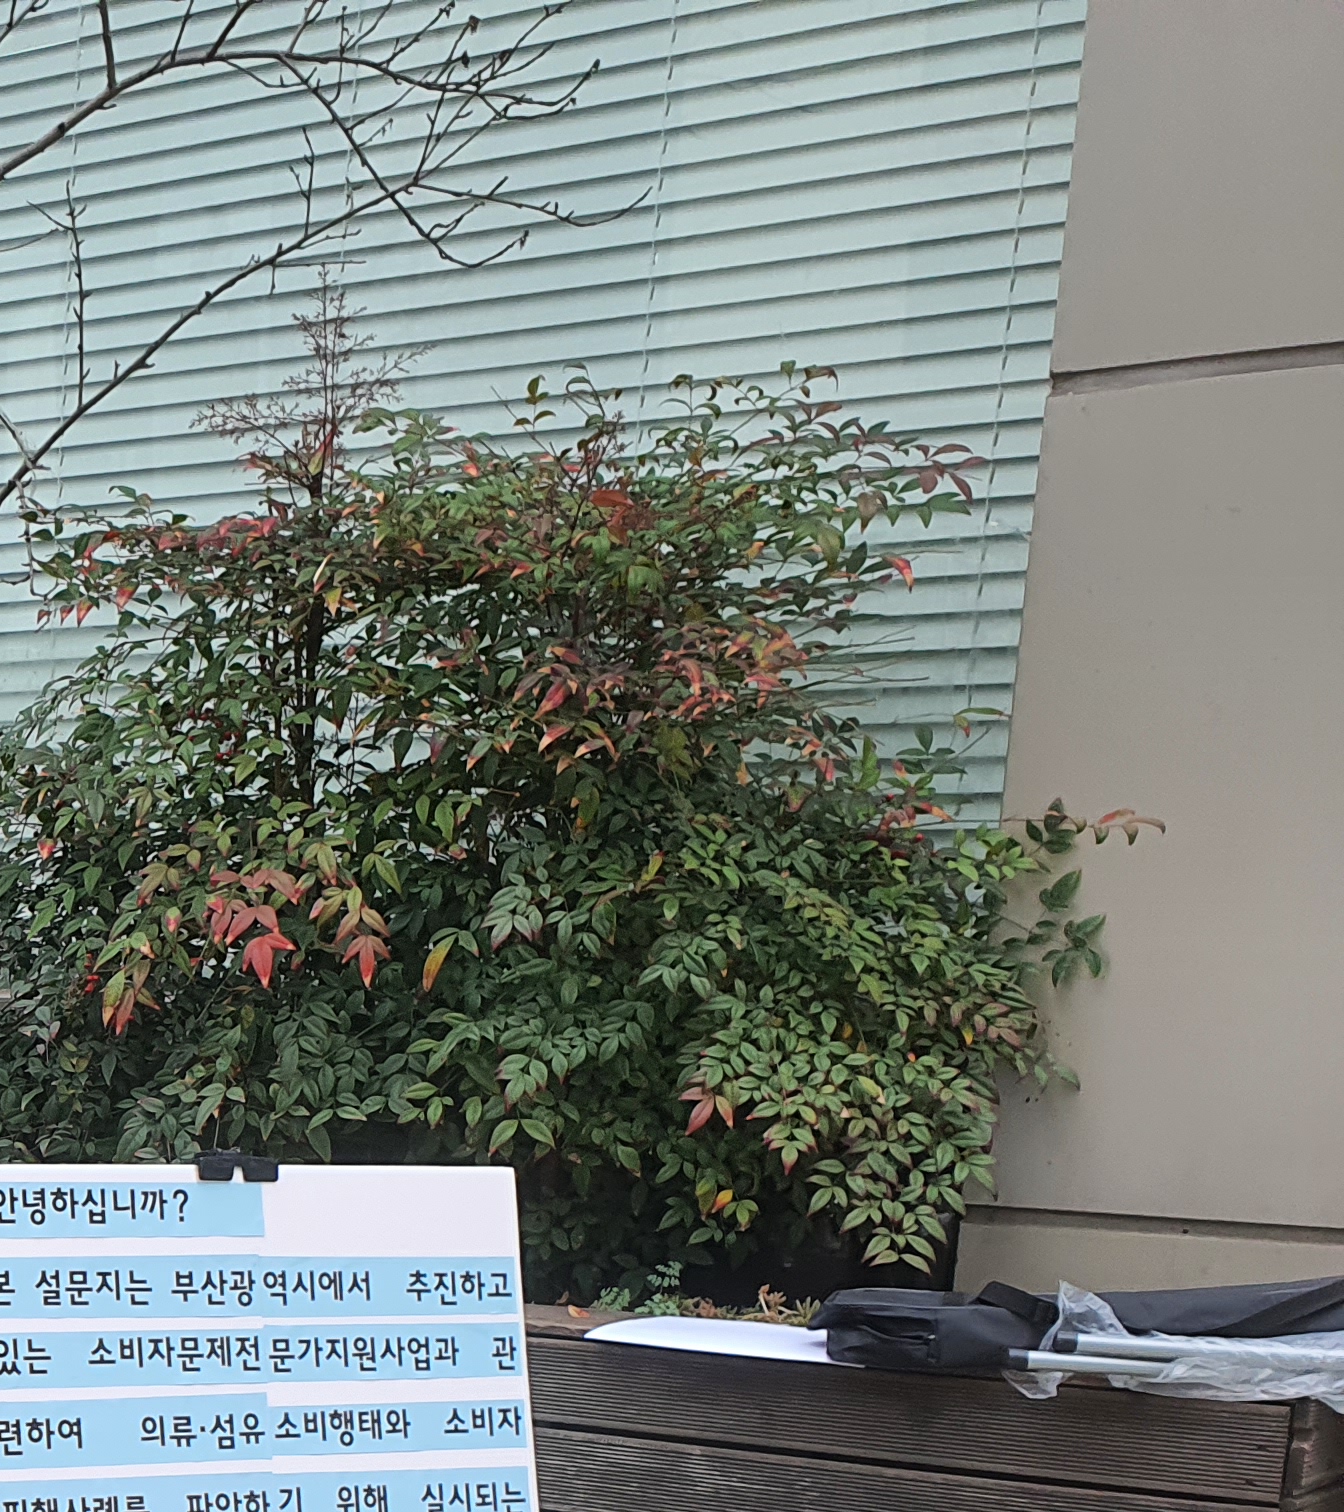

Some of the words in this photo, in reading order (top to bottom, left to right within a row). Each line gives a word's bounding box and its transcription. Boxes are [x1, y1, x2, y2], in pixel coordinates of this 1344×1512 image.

[35, 1269, 153, 1306] 설문지는
[171, 1269, 371, 1307] 부산광역시에서
[406, 1269, 513, 1306] 추진하고
[88, 1335, 460, 1373] 소비자문제전문가지원사업과
[491, 1336, 517, 1371] 관
[140, 1413, 266, 1450] 의류·섬유
[274, 1408, 411, 1447] 소비행태와
[444, 1406, 522, 1437] 소비자
